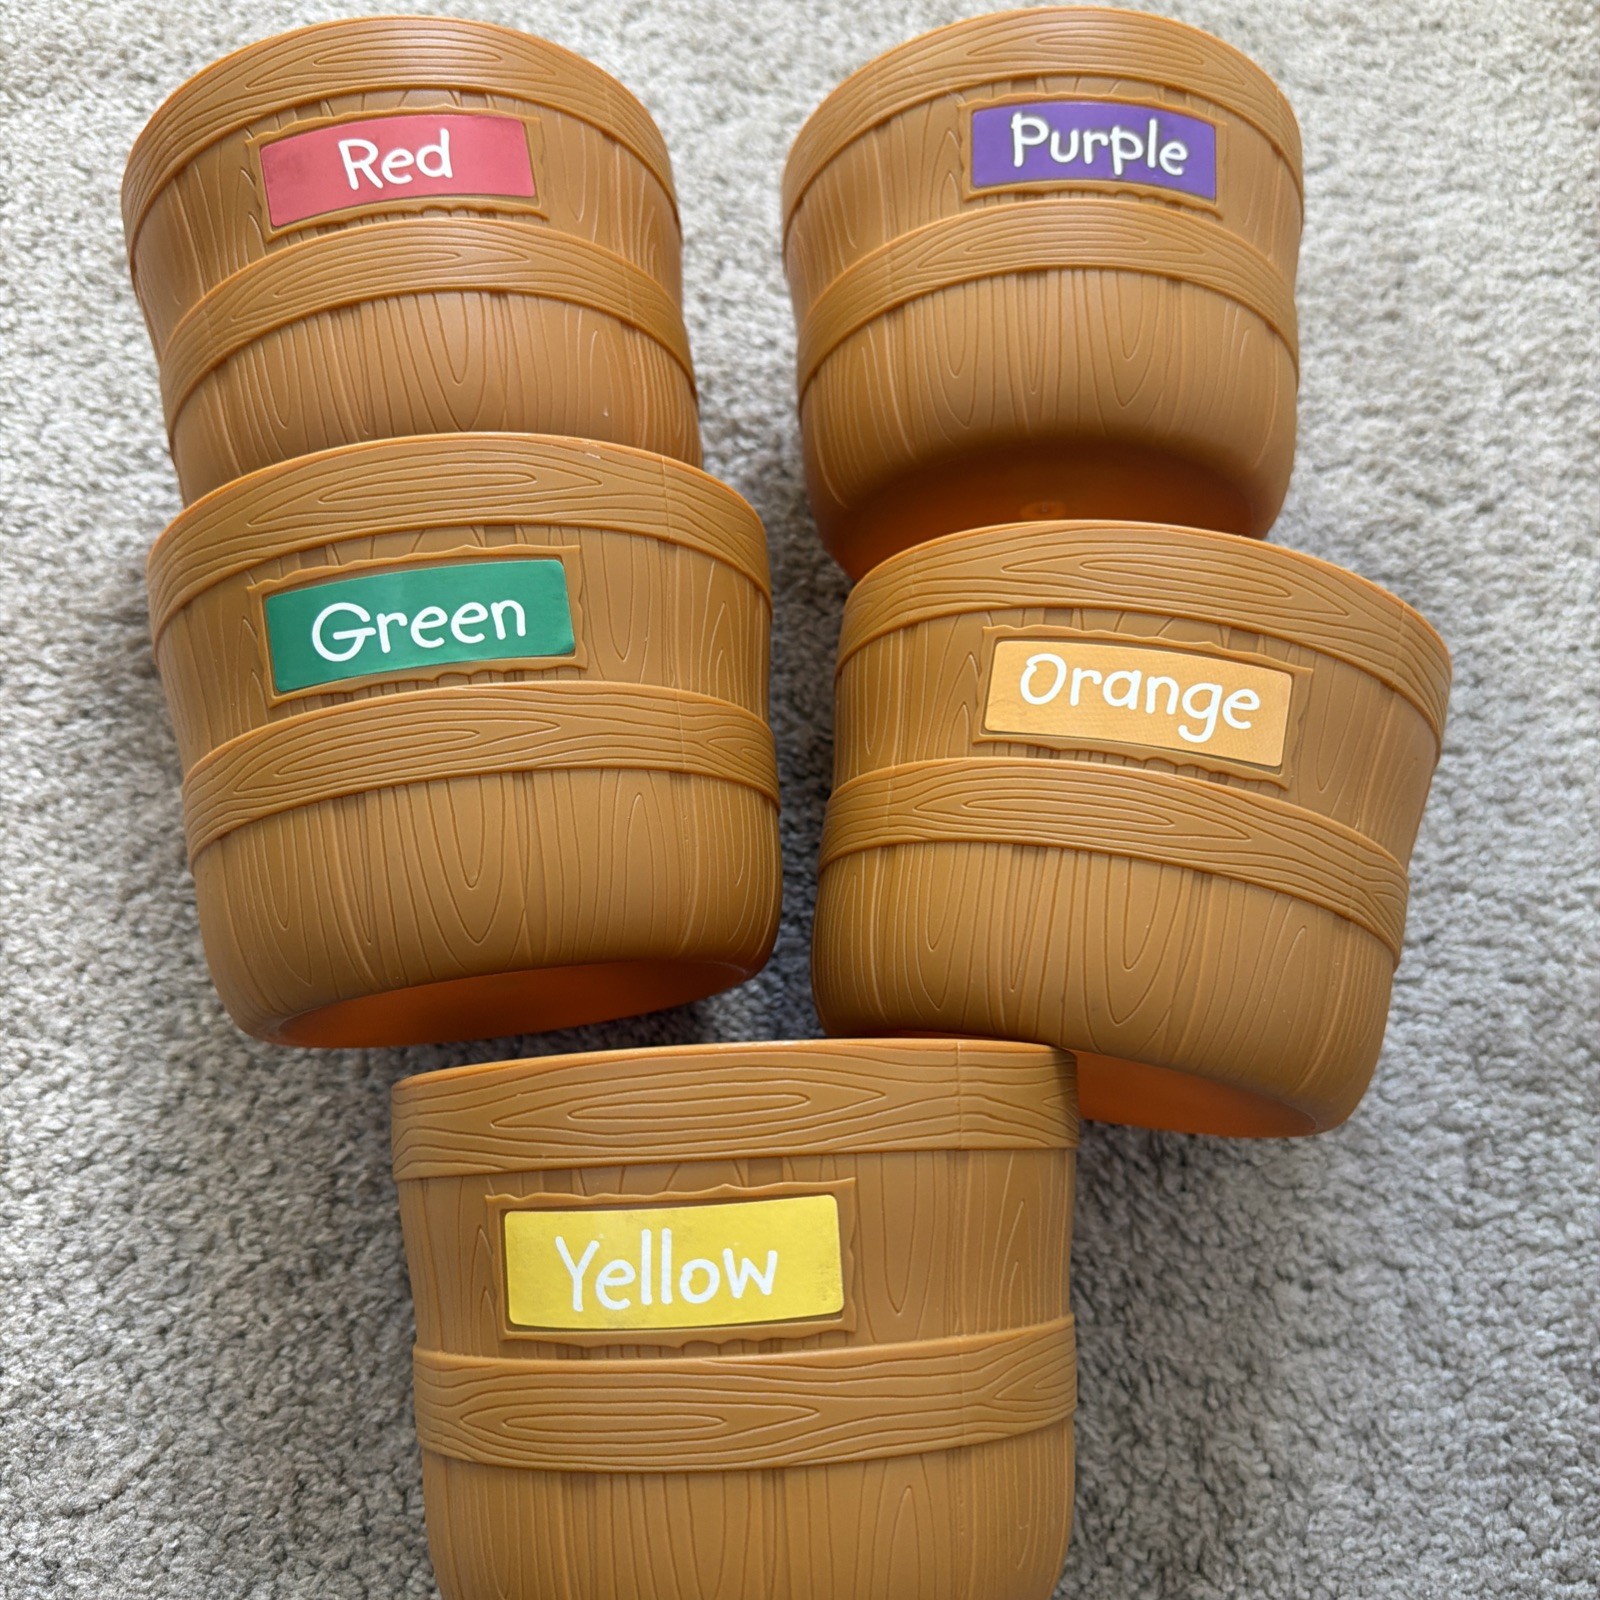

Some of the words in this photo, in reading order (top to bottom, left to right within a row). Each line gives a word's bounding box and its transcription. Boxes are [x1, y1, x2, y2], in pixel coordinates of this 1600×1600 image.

[338, 128, 453, 190] Red
[1011, 111, 1189, 177] Purple
[311, 599, 527, 662] Green
[1020, 653, 1261, 743] Orange
[555, 1227, 778, 1312] Yellow
